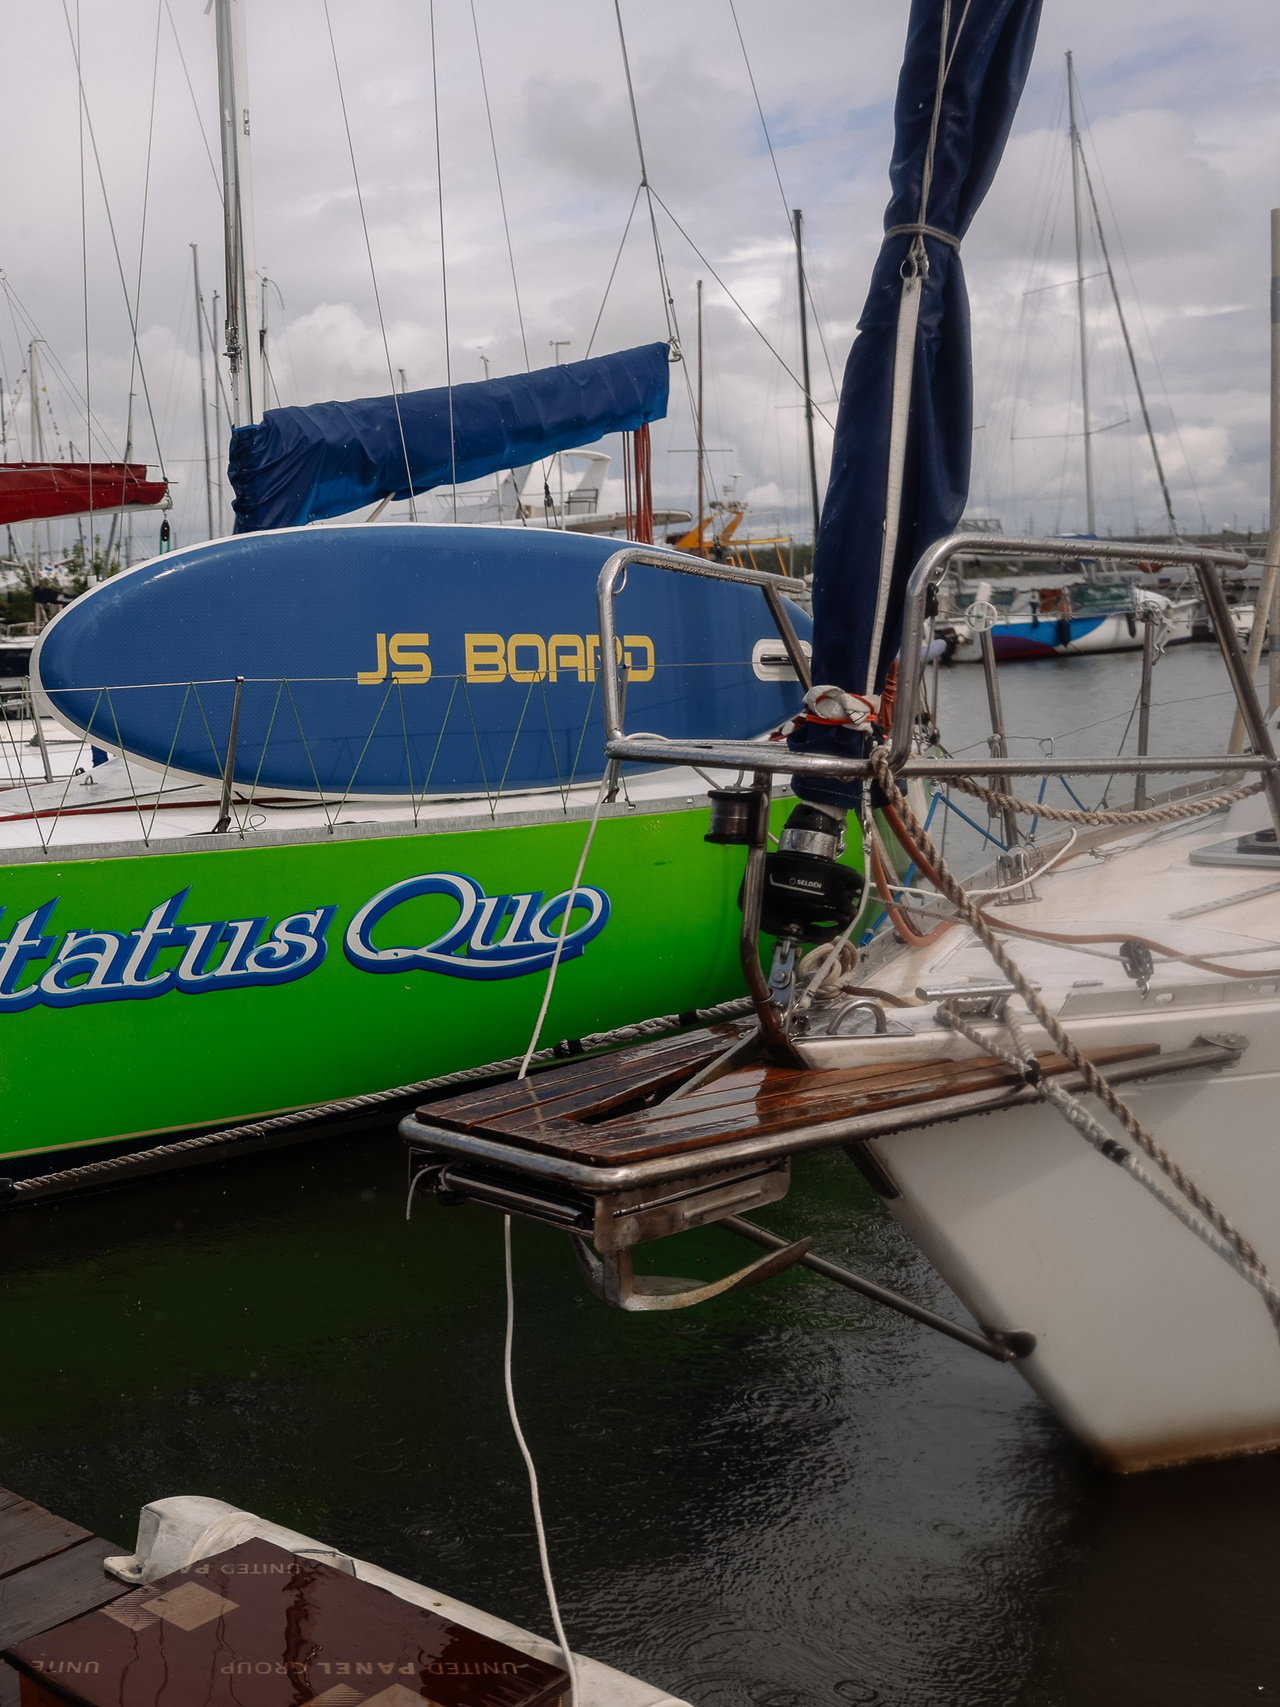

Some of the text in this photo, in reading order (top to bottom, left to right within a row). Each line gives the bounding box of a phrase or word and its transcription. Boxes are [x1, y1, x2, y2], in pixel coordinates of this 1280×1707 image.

[357, 633, 432, 685] JS
[343, 871, 611, 980] Quo
[221, 1563, 300, 1575] UNITED
[221, 1661, 518, 1675] UNITED PANEL GROUP
